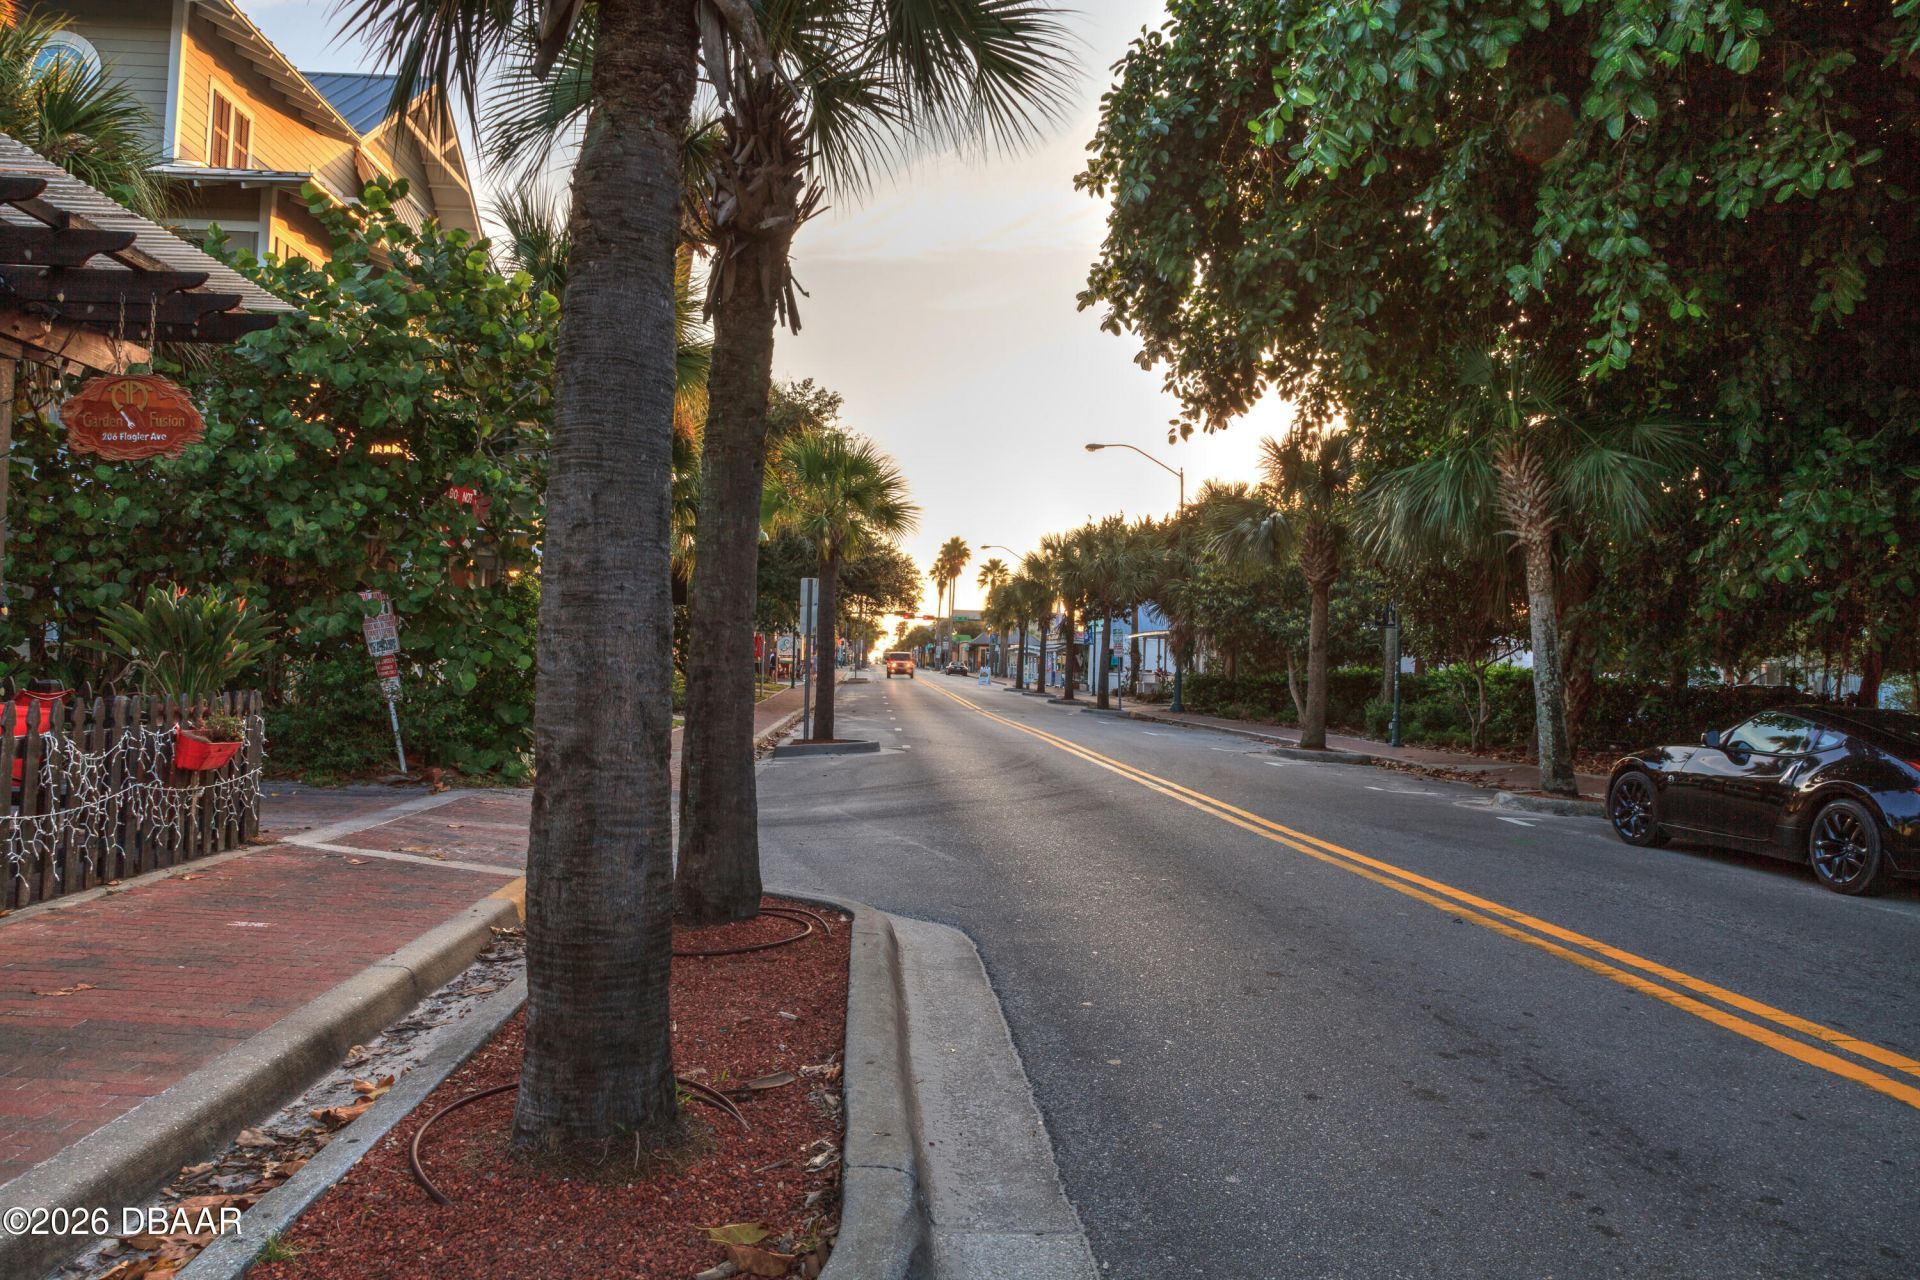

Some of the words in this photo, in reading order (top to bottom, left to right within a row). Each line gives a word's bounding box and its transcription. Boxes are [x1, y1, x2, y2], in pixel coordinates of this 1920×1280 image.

[82, 412, 122, 427] Garden
[149, 411, 185, 427] Fusion
[102, 432, 117, 441] 206
[120, 432, 149, 442] Flagler
[151, 432, 167, 441] Ave
[462, 491, 474, 504] NOT
